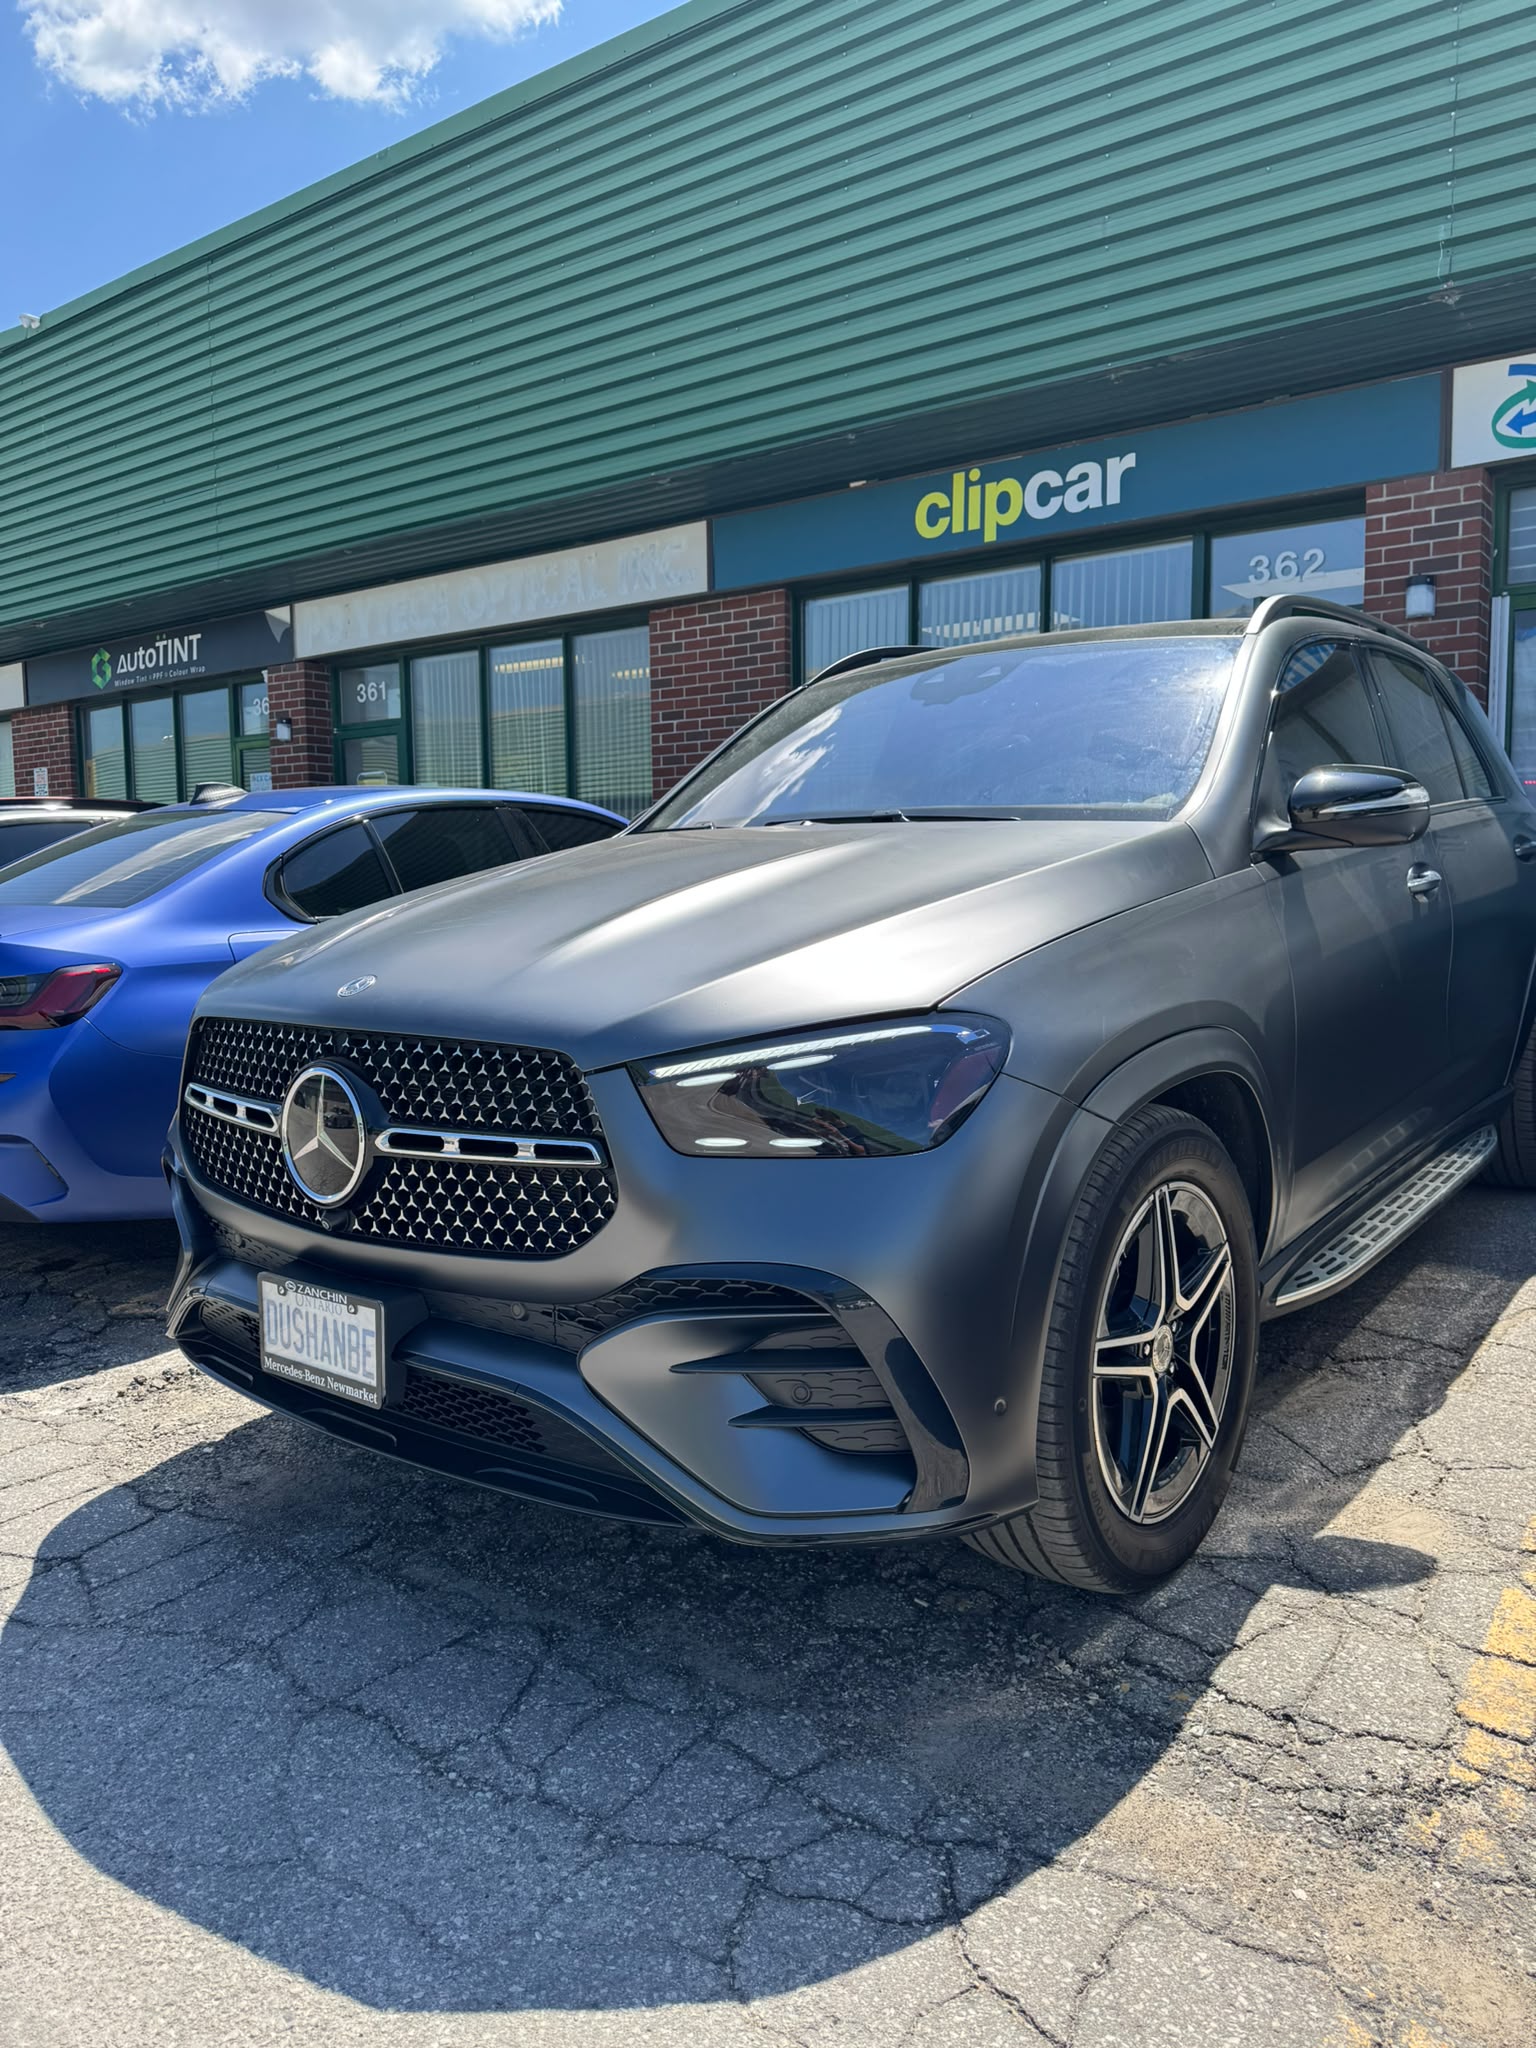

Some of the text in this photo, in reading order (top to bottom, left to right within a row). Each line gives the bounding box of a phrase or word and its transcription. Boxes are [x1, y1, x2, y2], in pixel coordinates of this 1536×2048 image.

[914, 451, 1138, 543] clipcar
[1247, 548, 1327, 586] 362
[114, 678, 135, 687] Window
[152, 671, 164, 680] PPF
[168, 667, 189, 678] Colour
[190, 665, 206, 674] Wrap
[253, 697, 270, 716] 36
[356, 681, 387, 703] 361
[297, 1284, 348, 1305] ZANCHIN
[266, 1300, 375, 1381] DUSHANBE
[263, 1356, 378, 1405] Mercedes-Benz Newmarket
